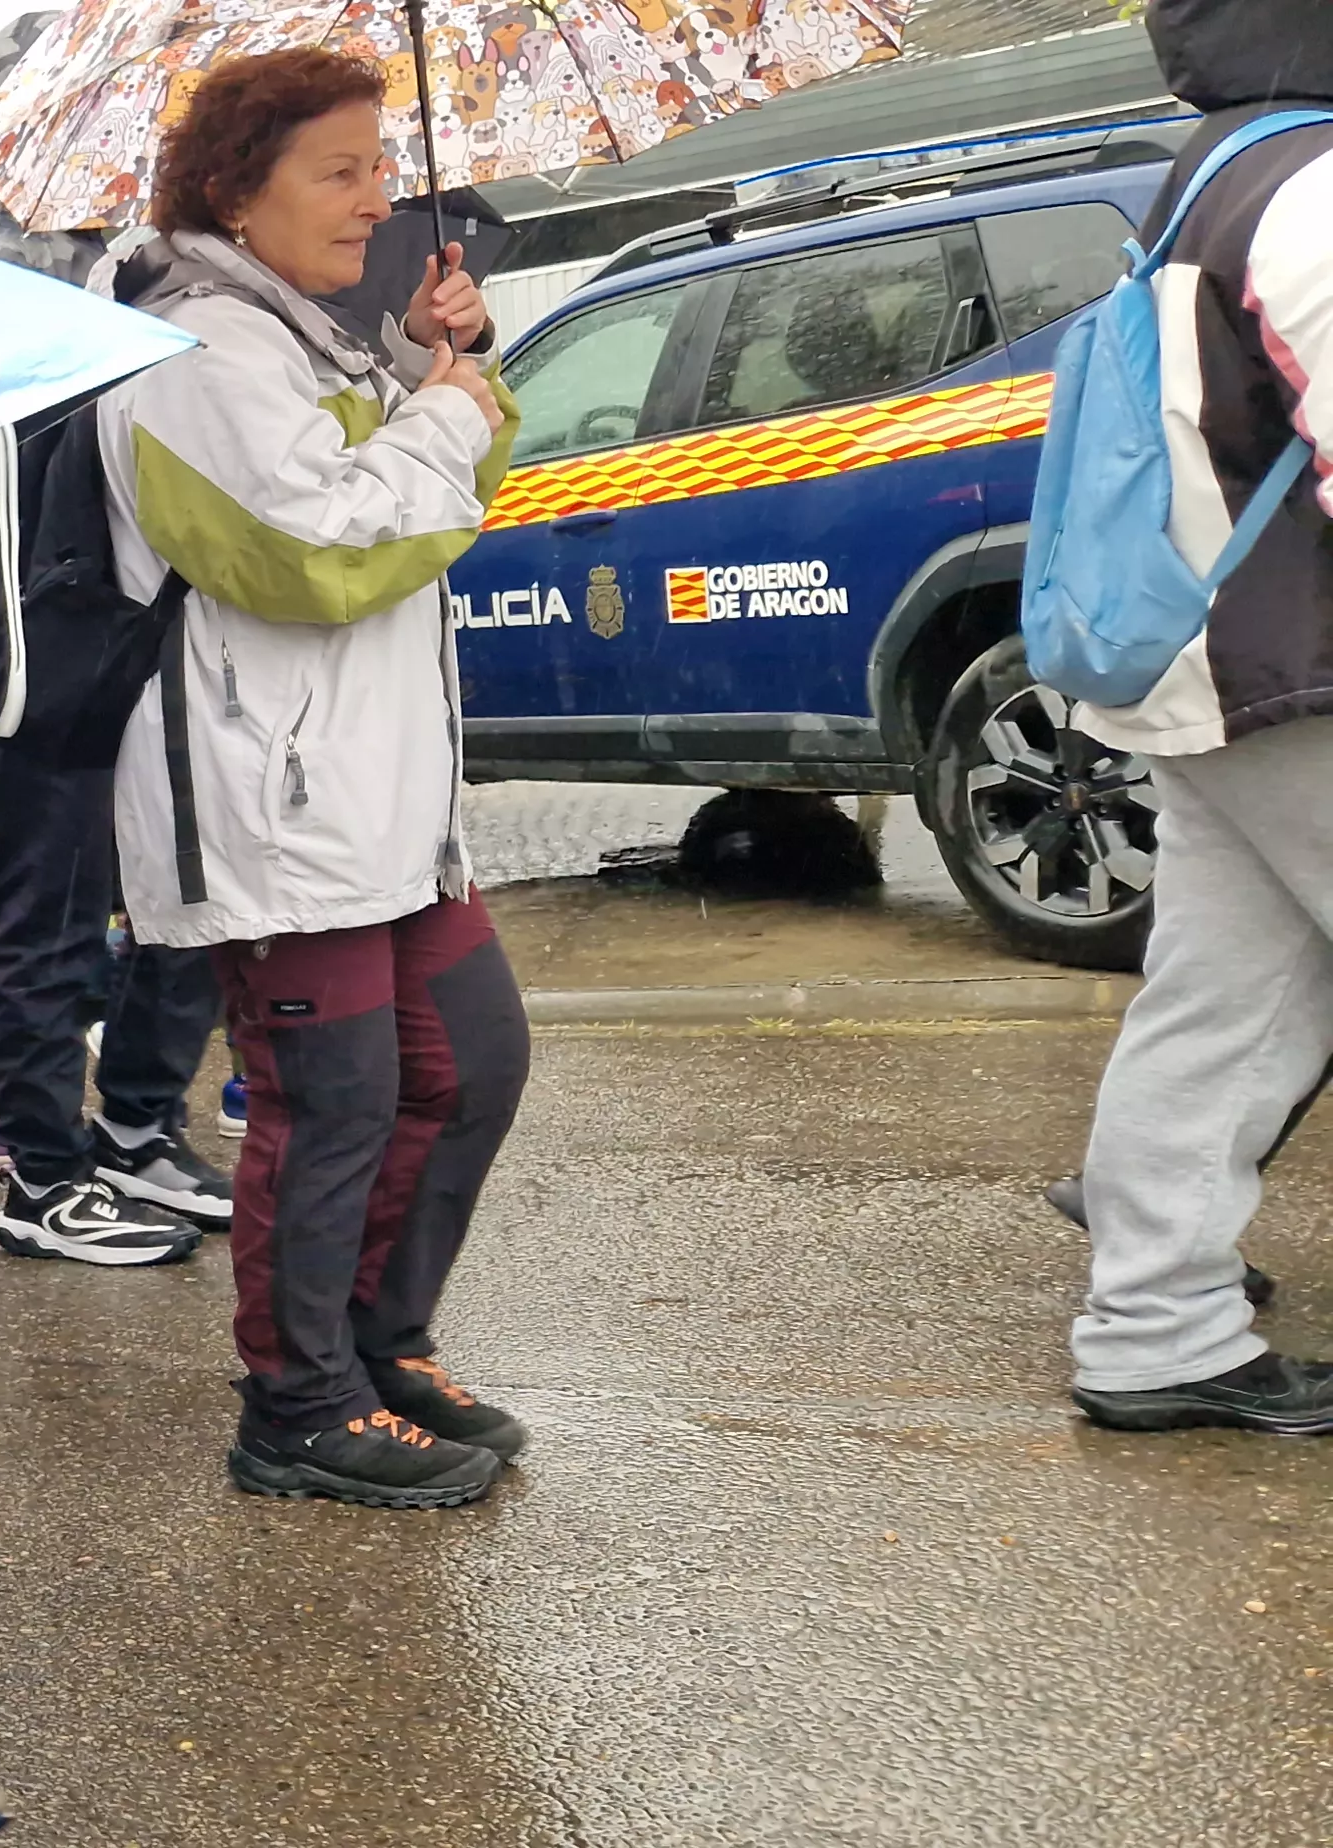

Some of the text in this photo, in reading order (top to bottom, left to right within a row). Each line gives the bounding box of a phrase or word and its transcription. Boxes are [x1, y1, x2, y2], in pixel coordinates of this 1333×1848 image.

[707, 559, 830, 595] GOBIERNO
[450, 581, 573, 631] OLICÍA
[709, 587, 849, 621] DE ARAGON
